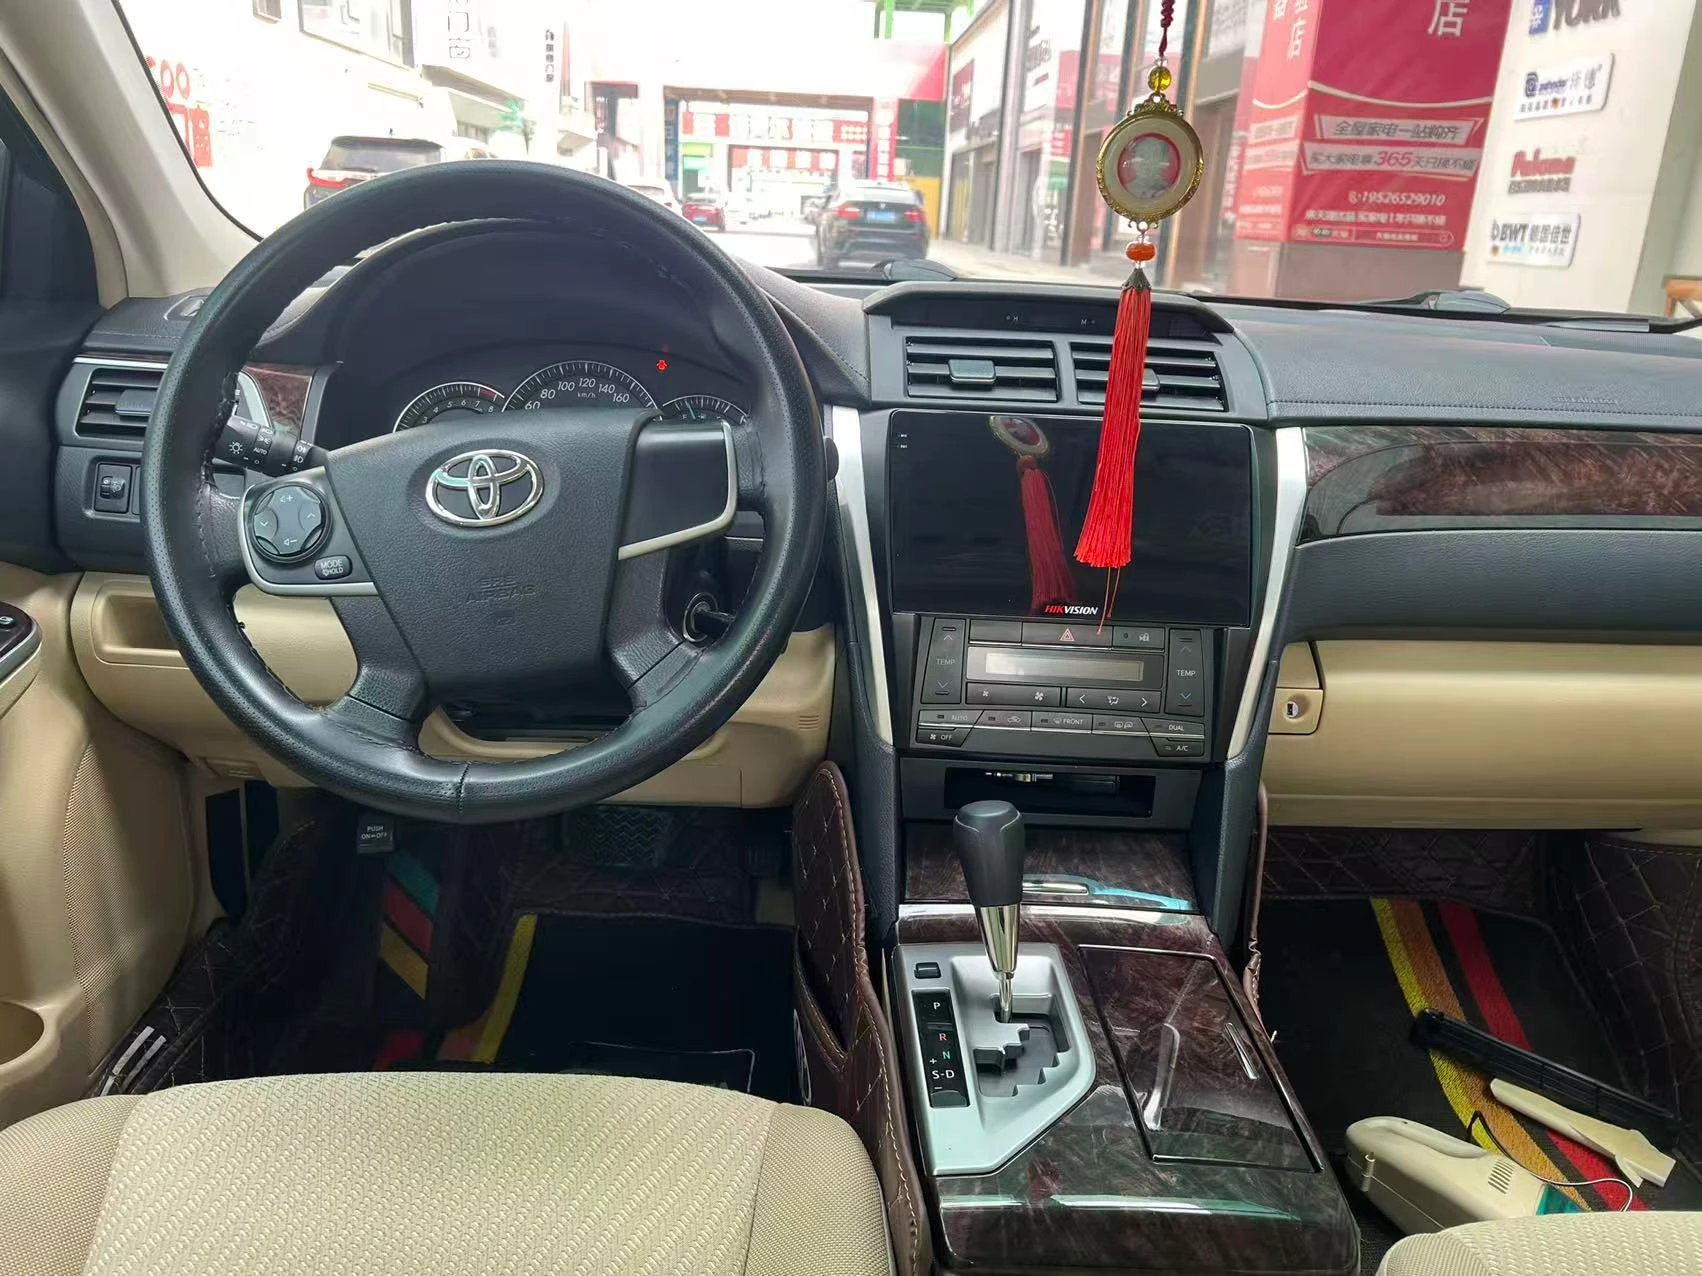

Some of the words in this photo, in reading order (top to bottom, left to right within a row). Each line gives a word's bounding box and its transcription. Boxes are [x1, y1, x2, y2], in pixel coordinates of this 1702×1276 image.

[1428, 0, 1470, 36] 店
[1500, 222, 1528, 243] BWT
[558, 381, 575, 392] 100
[579, 378, 596, 388] 120
[599, 384, 615, 394] 140
[540, 389, 556, 399] 80
[577, 391, 596, 399] km/h
[613, 393, 630, 403] 160
[525, 401, 541, 409] 60
[253, 447, 268, 455] AUTO
[320, 559, 344, 568] MODE
[328, 566, 344, 576] HOLD
[1044, 604, 1099, 615] HIKVISION
[936, 658, 956, 666] TEMP
[1176, 669, 1196, 677] TEMP
[951, 714, 969, 722] AUTO
[1063, 718, 1083, 726] FRONT
[1168, 724, 1185, 732] DUAL
[933, 1001, 941, 1010] P
[939, 1032, 948, 1041] R
[942, 1051, 951, 1060] N
